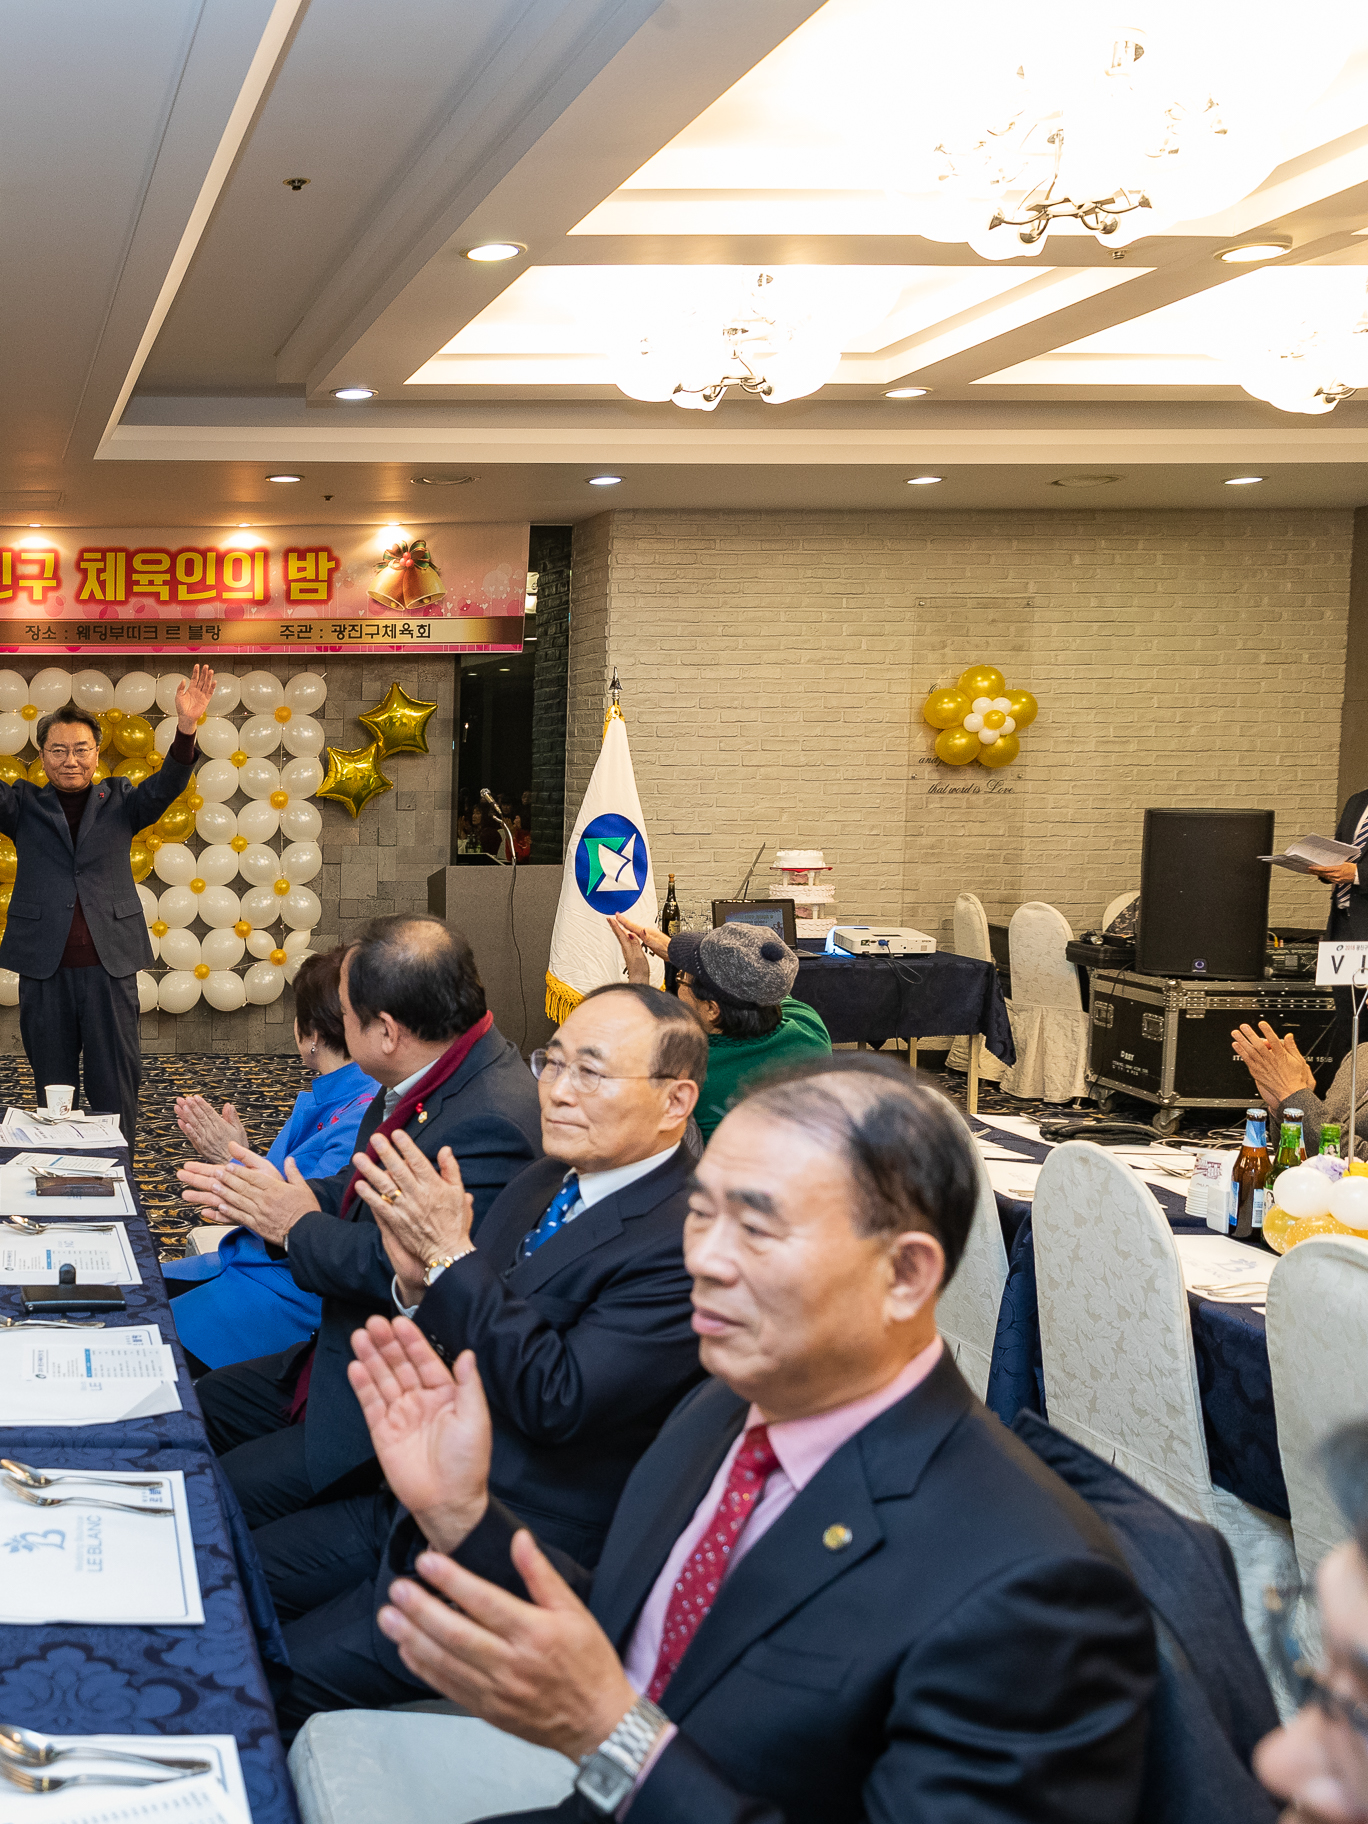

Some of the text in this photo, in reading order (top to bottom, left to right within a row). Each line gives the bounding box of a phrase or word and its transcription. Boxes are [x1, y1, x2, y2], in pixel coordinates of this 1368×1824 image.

[79, 551, 264, 601] 체육인의
[287, 551, 336, 600] 밤
[25, 624, 58, 641] 장소
[76, 624, 159, 641] 웨딩부띠크
[165, 625, 182, 640] 르
[188, 624, 222, 641] 블랑
[279, 623, 313, 640] 주관
[330, 623, 432, 640] 광진구체육회
[949, 783, 974, 794] word
[86, 1514, 103, 1572] LE BLANC
